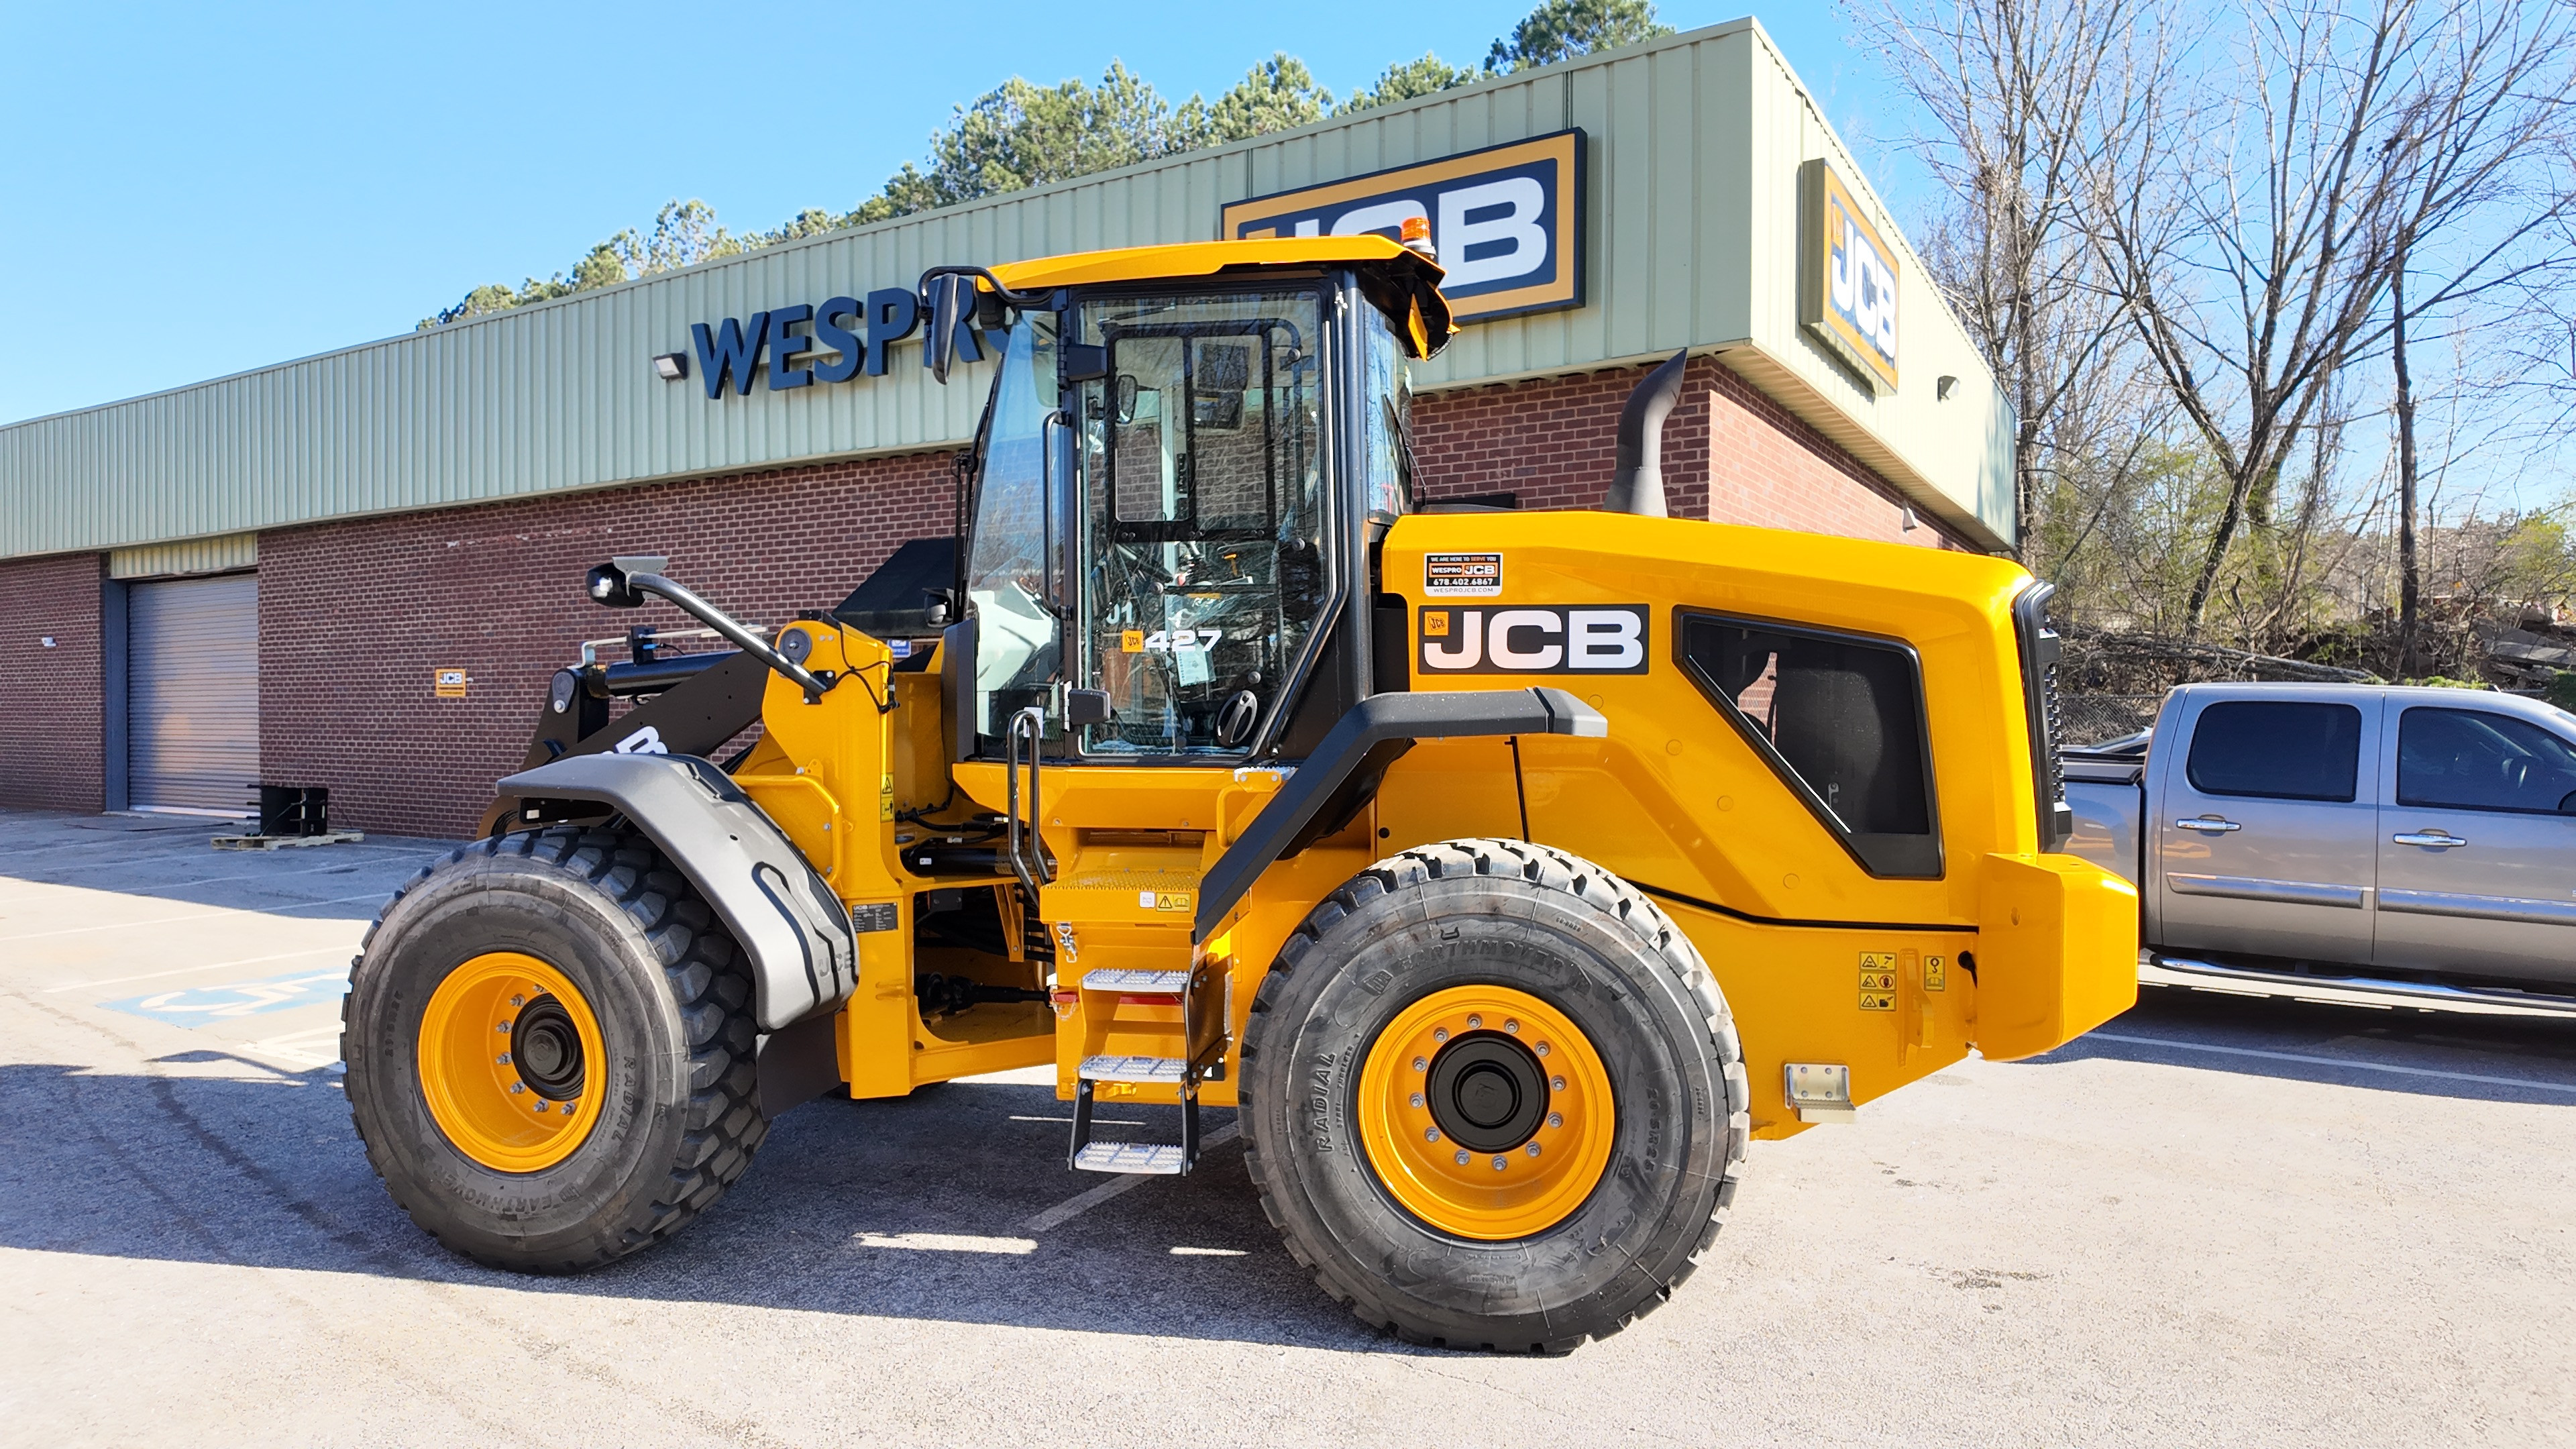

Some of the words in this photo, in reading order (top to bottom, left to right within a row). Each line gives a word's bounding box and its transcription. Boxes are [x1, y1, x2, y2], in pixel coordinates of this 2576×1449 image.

[1831, 219, 1896, 358] JCB
[690, 278, 1006, 400] WESPR
[1433, 578, 1493, 586] 678.402.6867
[1464, 565, 1495, 575] JCB
[1145, 630, 1222, 652] 427
[1424, 610, 1644, 669] JCB
[1430, 617, 1445, 629] JCB
[439, 672, 462, 684] JCB
[611, 1056, 636, 1142] RADIAL
[1313, 1052, 1338, 1152] RADIAL
